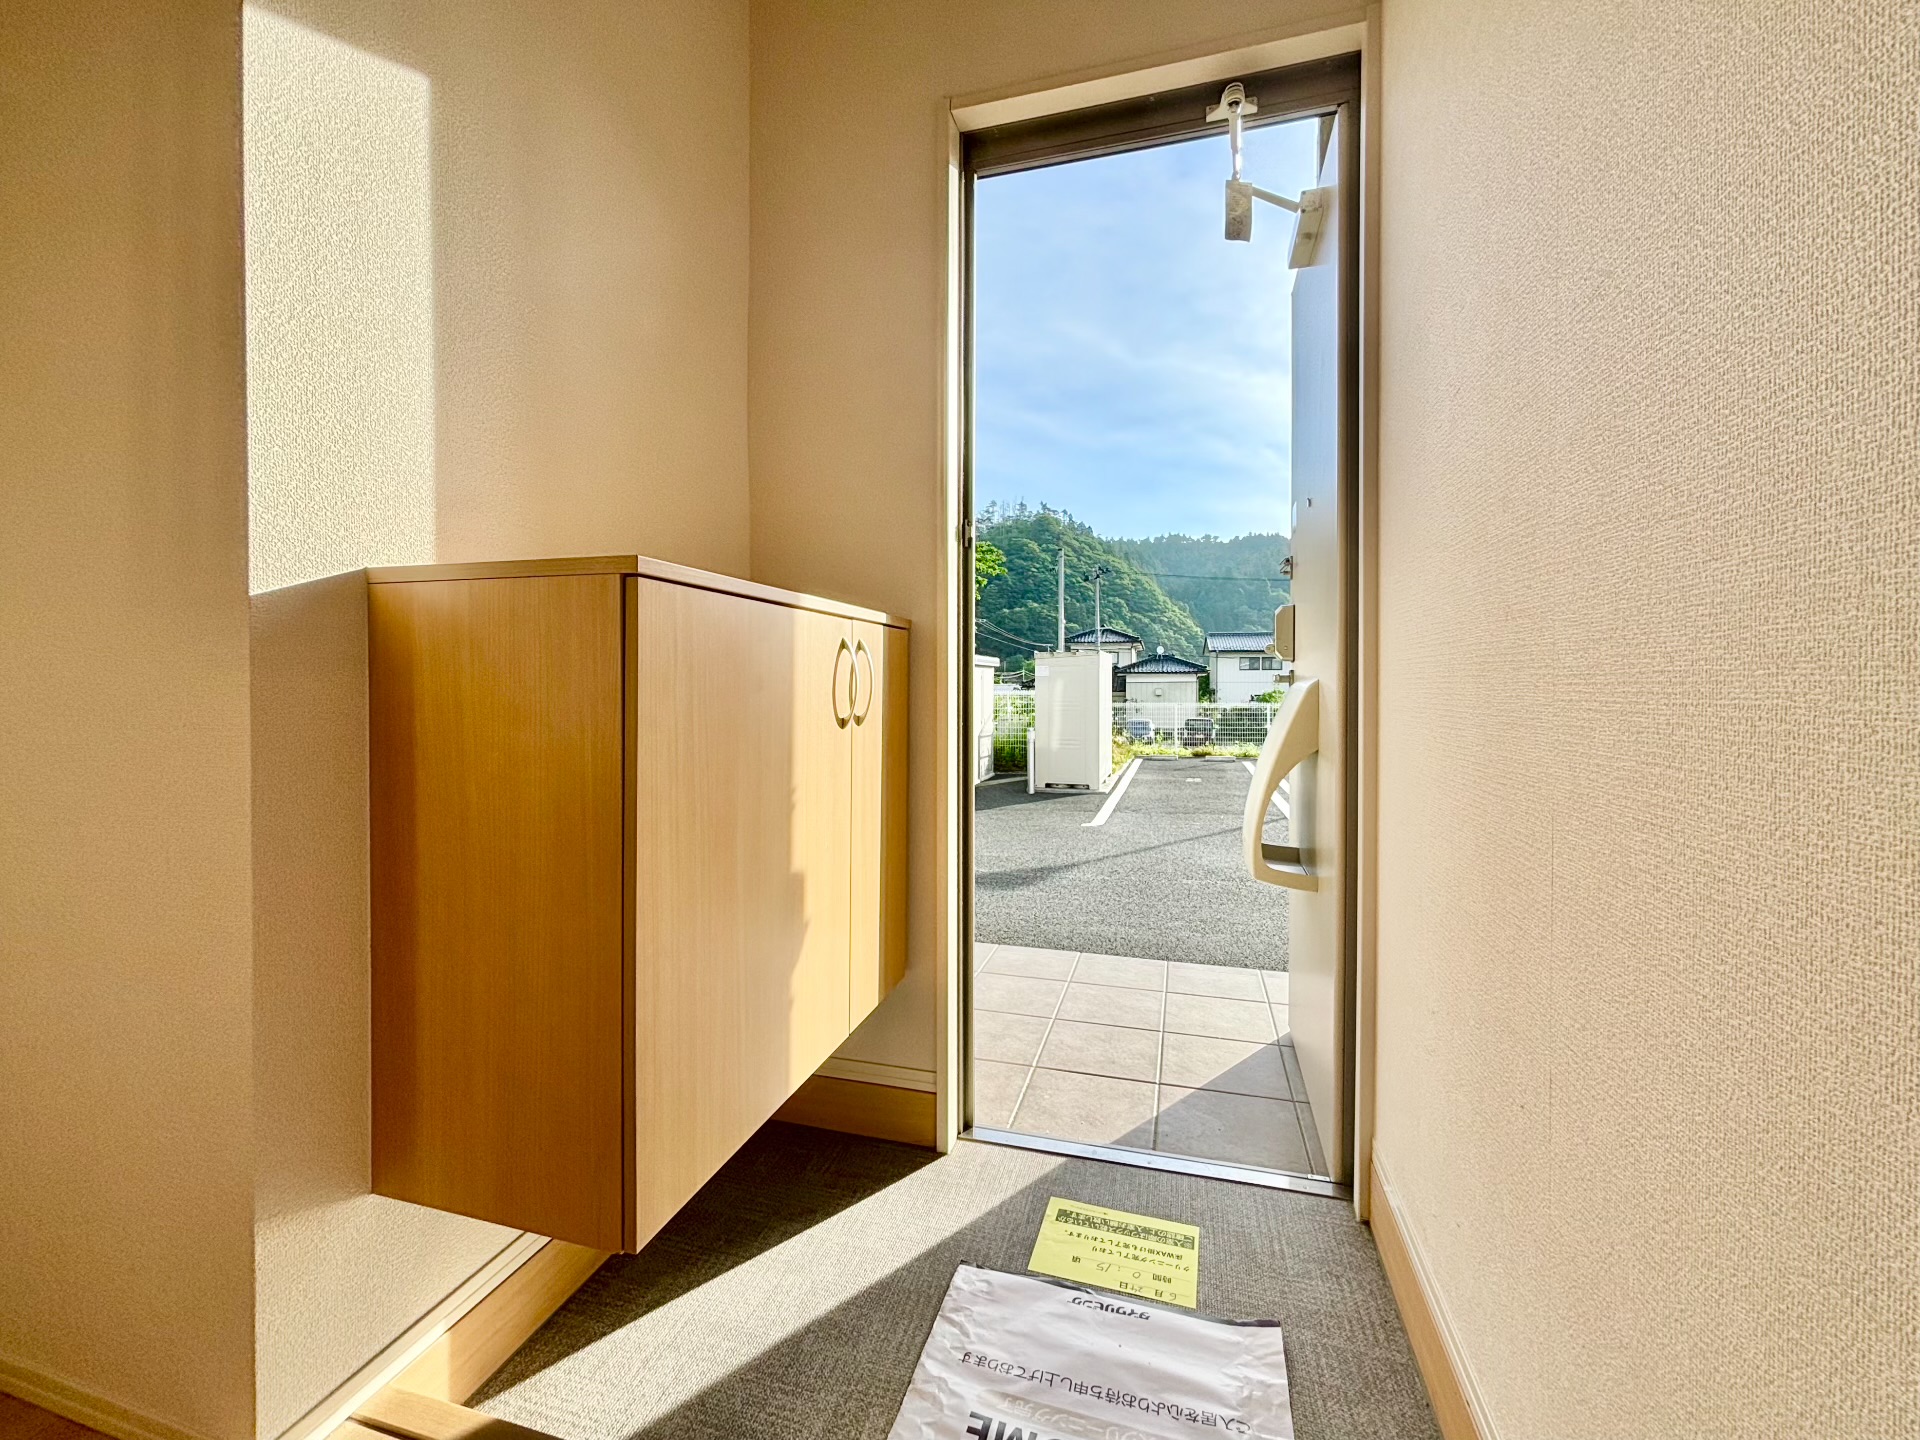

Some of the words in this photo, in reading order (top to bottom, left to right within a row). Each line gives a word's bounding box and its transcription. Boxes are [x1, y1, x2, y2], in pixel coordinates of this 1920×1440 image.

[1067, 1297, 1151, 1320] ダイワリビング
[958, 1351, 1251, 1434] ご入居を心よりお待ち申し上げております
